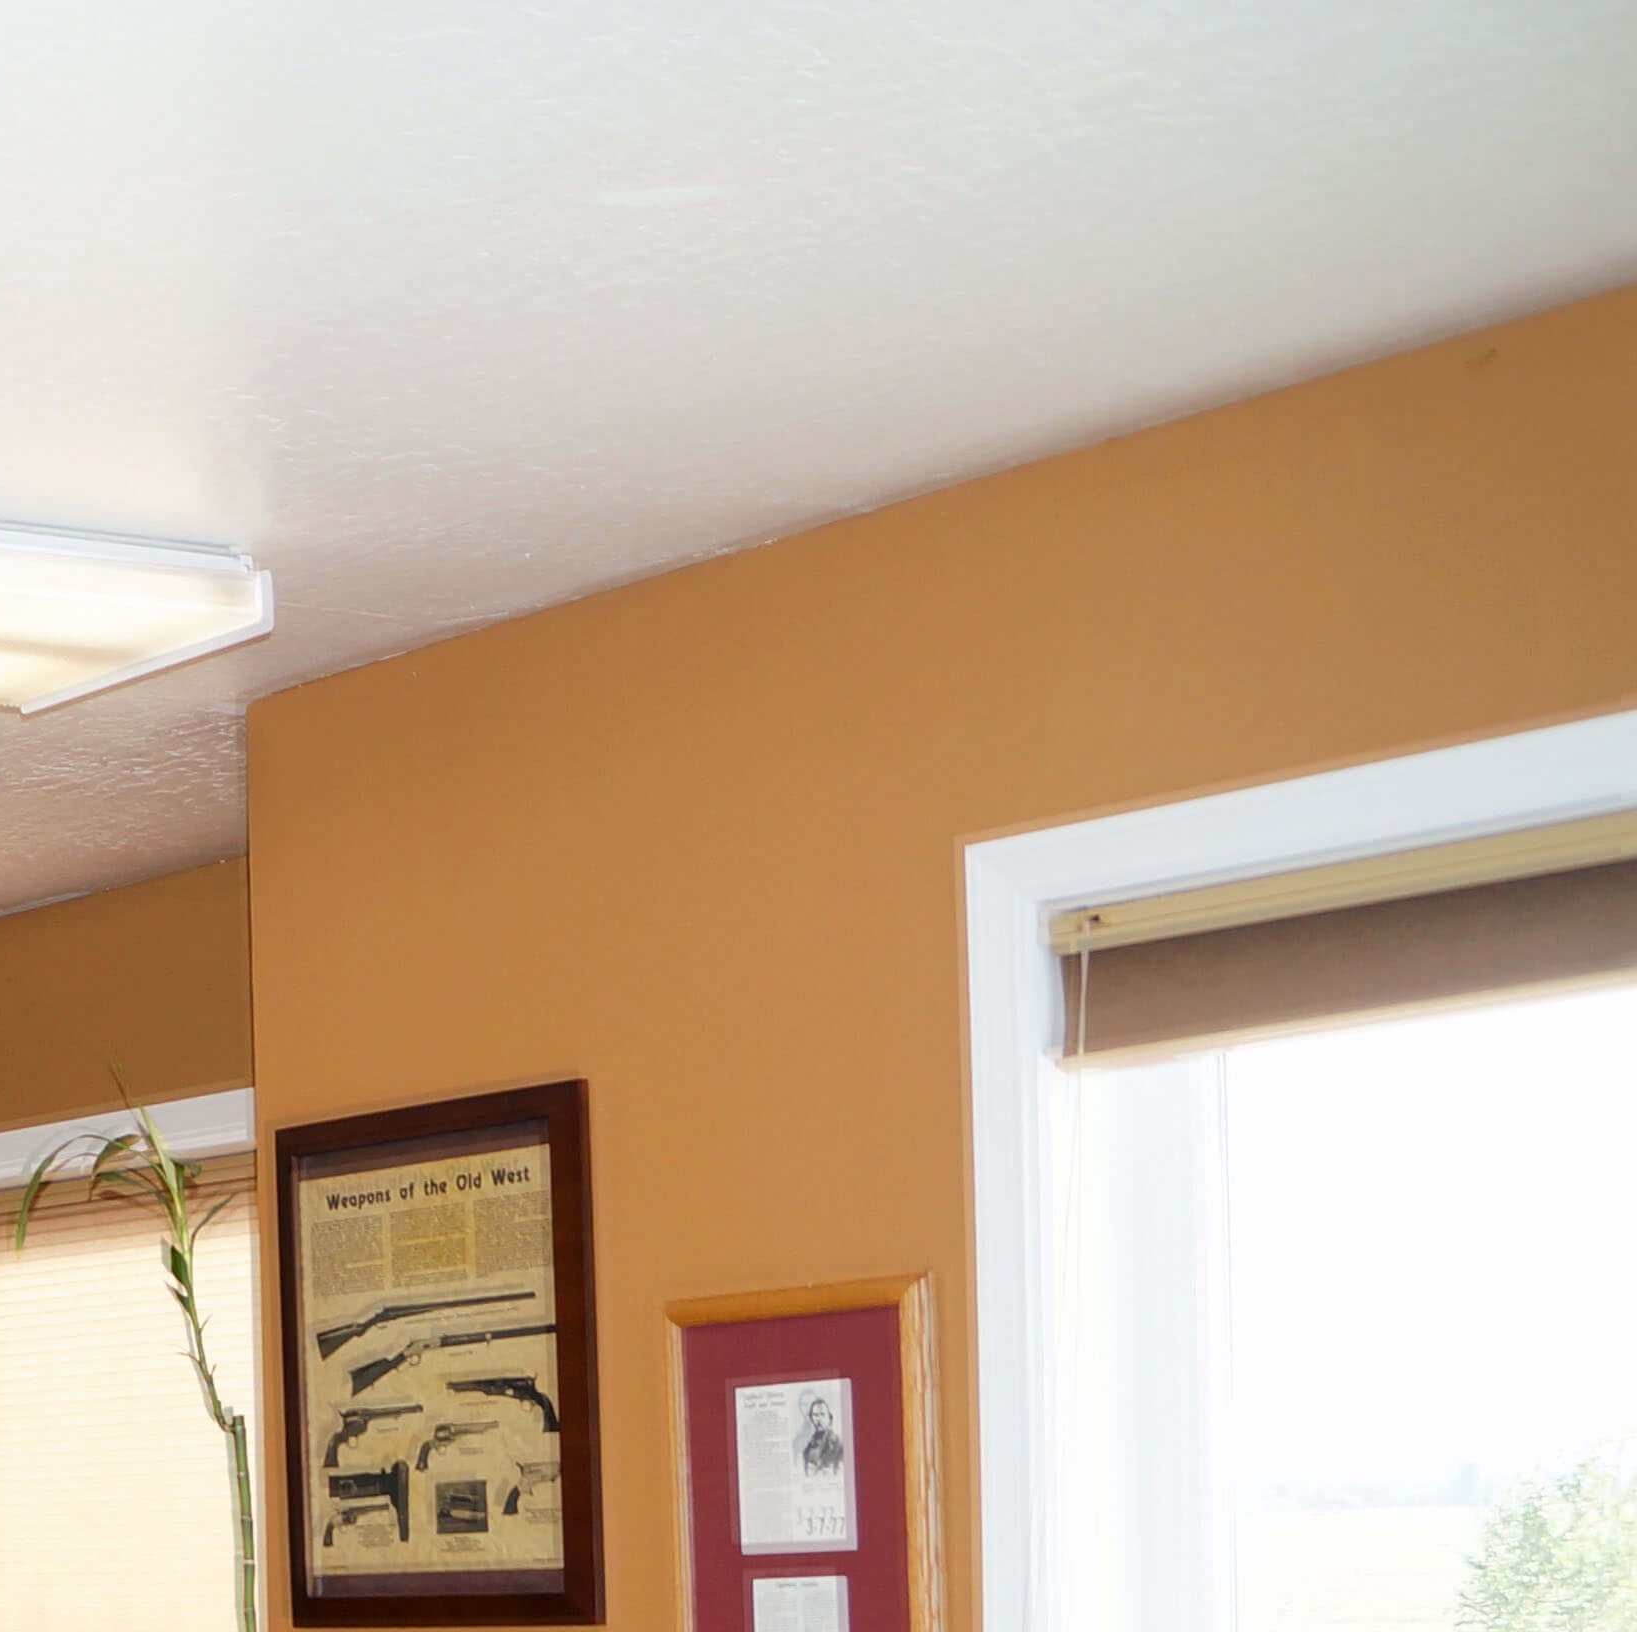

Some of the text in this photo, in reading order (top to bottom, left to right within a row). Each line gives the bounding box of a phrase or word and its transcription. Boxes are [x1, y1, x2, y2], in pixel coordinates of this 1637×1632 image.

[326, 1166, 531, 1210] Weapons of the Old West
